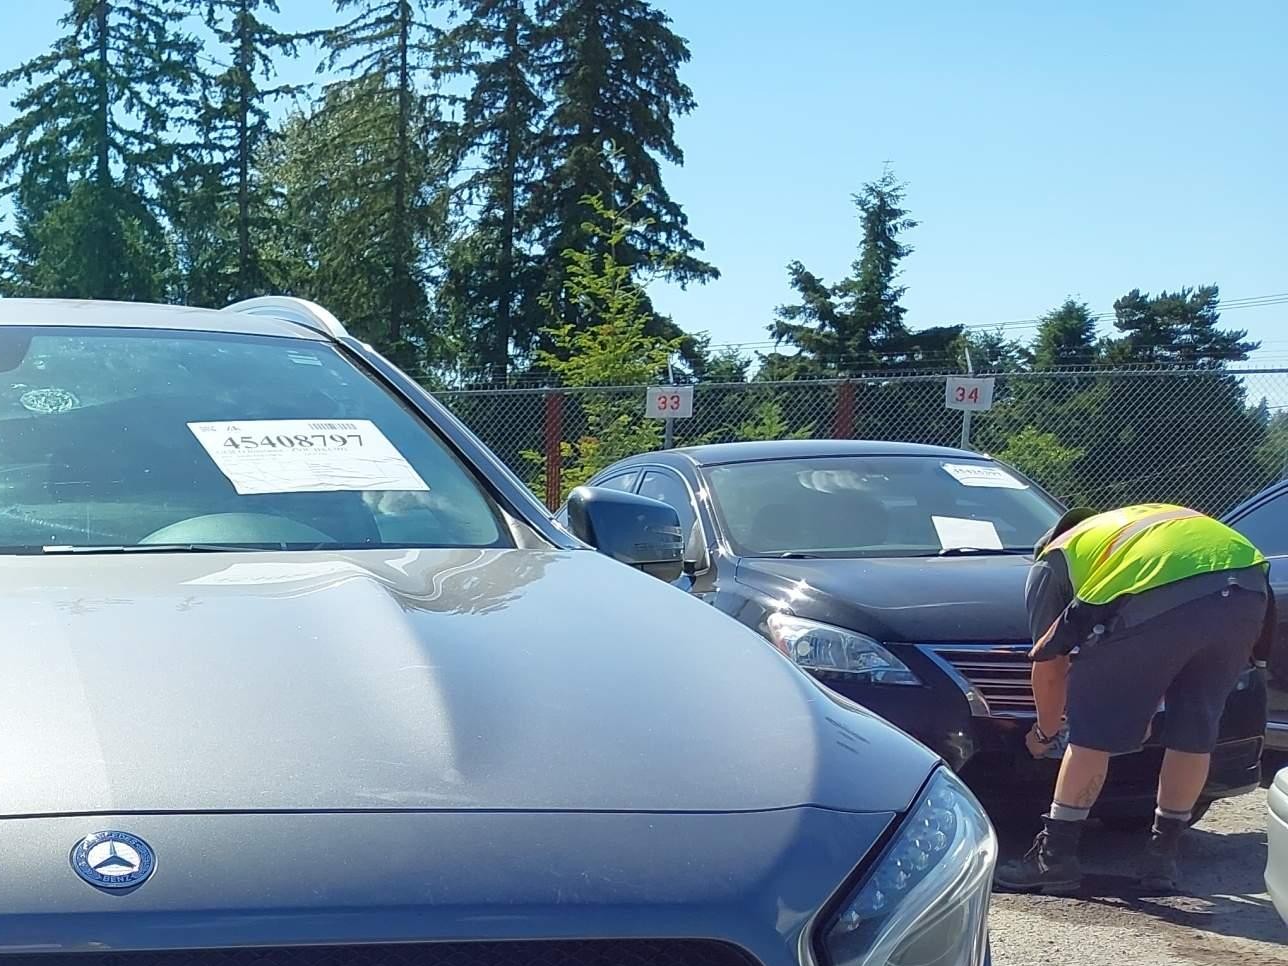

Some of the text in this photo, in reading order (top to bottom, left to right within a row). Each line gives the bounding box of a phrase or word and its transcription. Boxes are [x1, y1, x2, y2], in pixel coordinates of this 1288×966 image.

[657, 394, 681, 411] 33
[954, 386, 979, 404] 34
[223, 433, 364, 449] 45408797
[102, 874, 133, 883] BENZ
